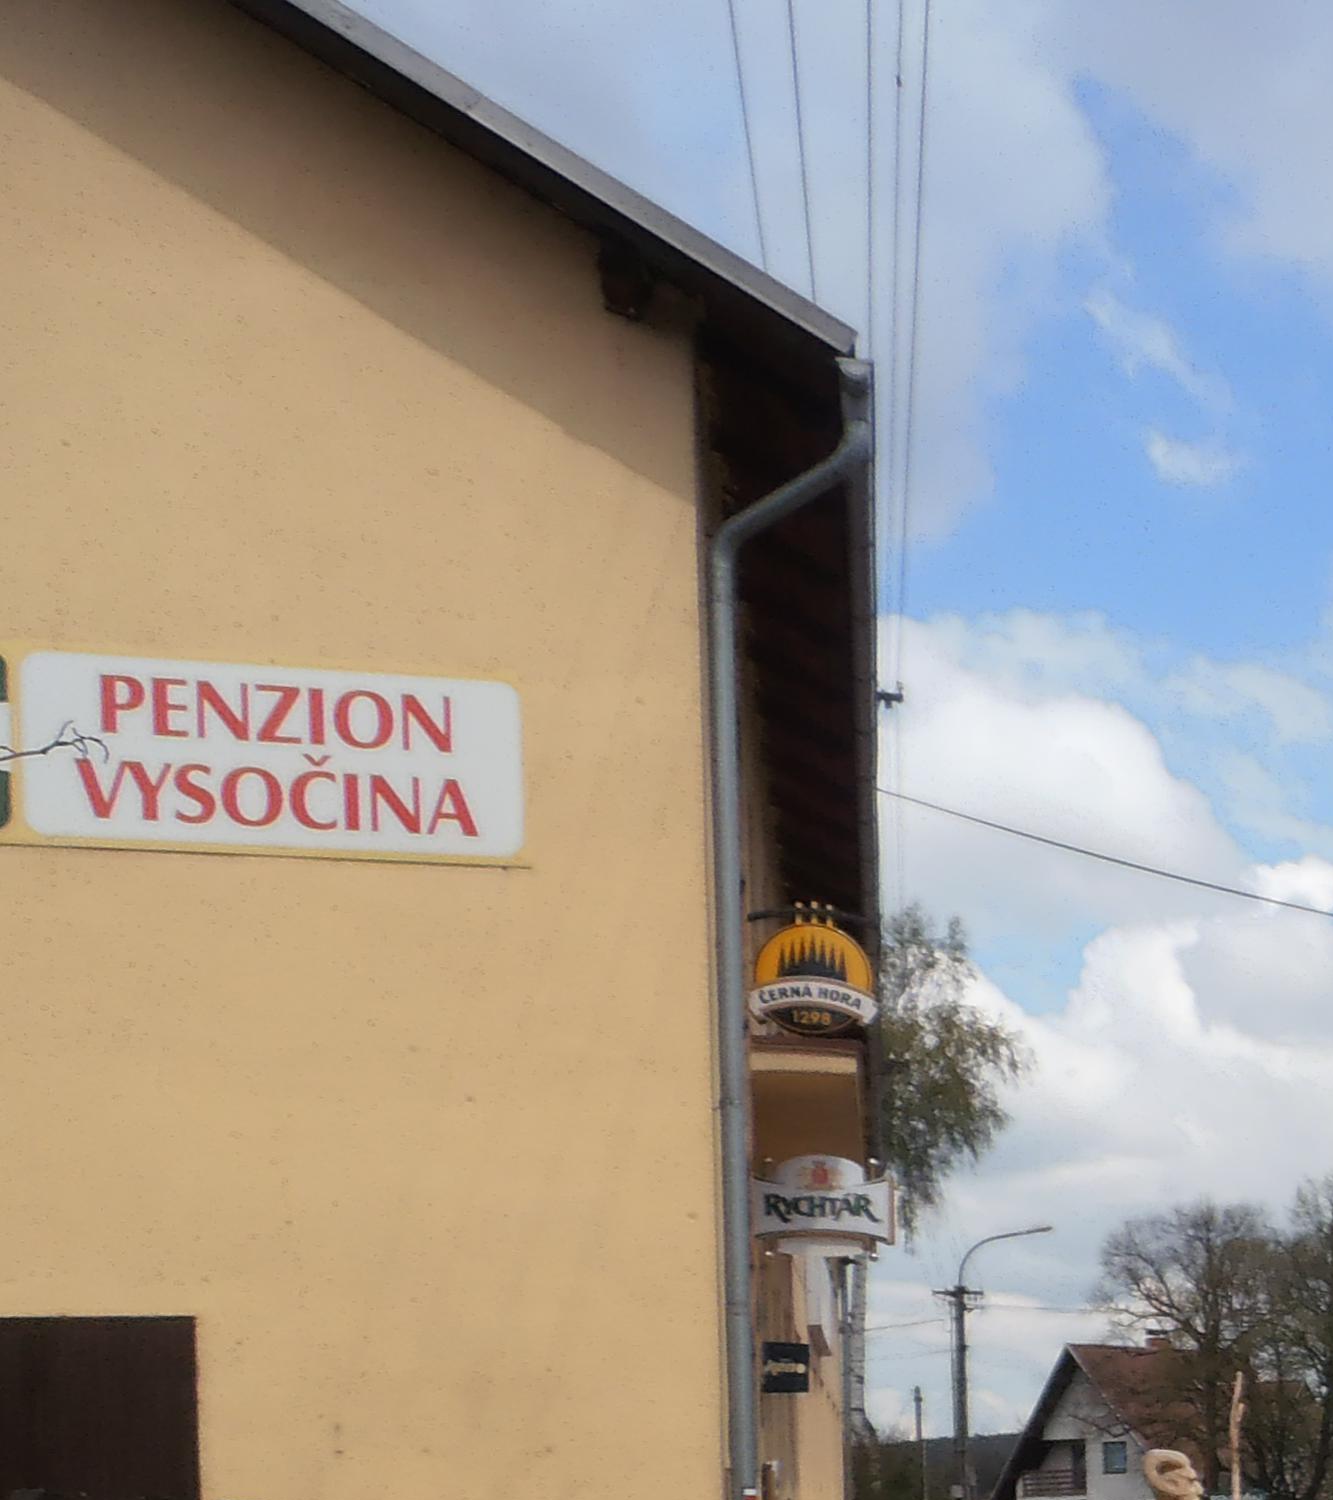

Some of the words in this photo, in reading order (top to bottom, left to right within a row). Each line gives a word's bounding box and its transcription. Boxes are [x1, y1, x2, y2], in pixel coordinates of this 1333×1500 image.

[99, 673, 453, 754] PENZION
[74, 753, 480, 837] VYSOČINA
[791, 1009, 833, 1026] 1298
[818, 987, 862, 1010] HORA
